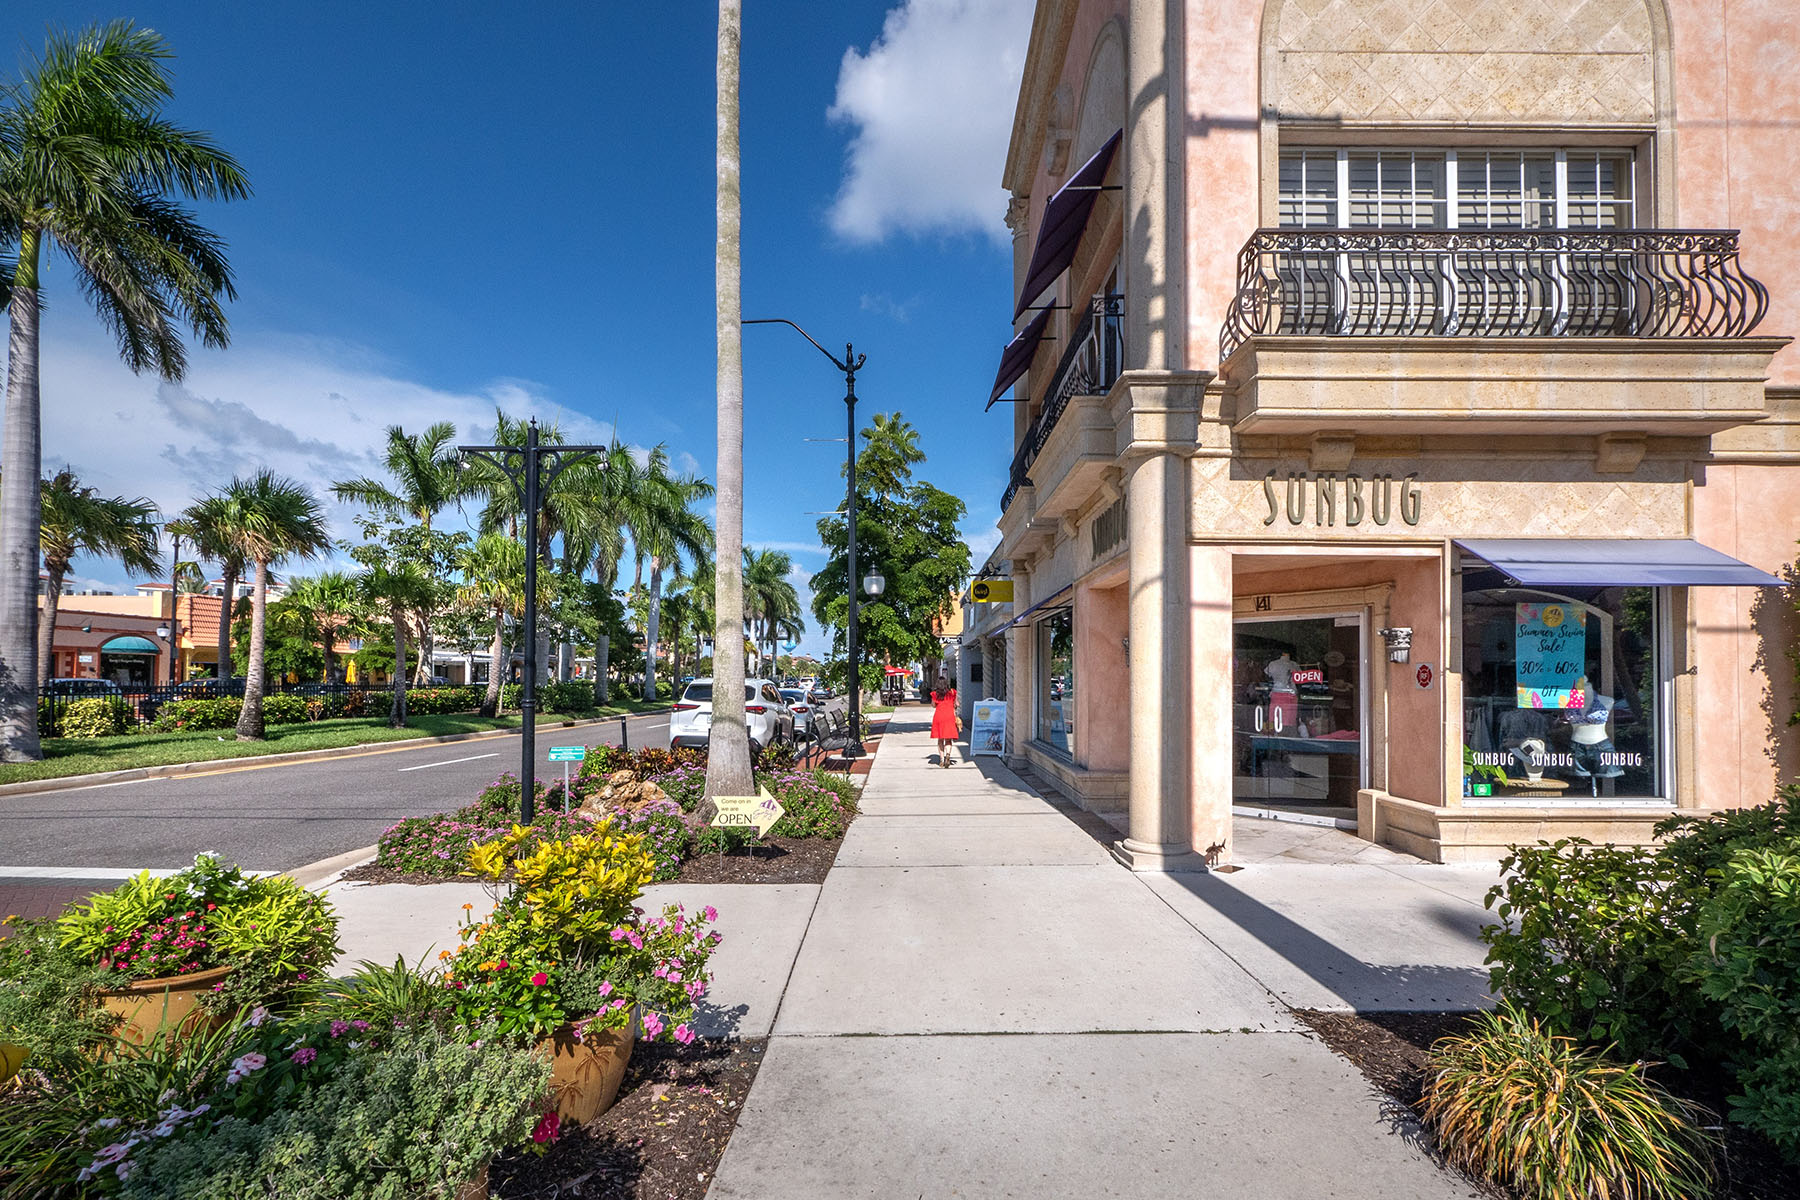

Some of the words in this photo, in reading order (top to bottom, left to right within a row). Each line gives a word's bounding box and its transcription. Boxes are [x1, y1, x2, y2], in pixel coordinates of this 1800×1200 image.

[1264, 469, 1421, 526] SUNBUG
[1517, 624, 1554, 638] Summer
[1557, 624, 1585, 638] Swim
[1537, 639, 1565, 653] Sale!
[1520, 661, 1544, 674] 30%
[1554, 661, 1579, 674] 60%
[1293, 671, 1321, 682] OPEN
[1472, 752, 1514, 766] SUNBUG
[1531, 752, 1573, 766] SUNBUG
[1600, 752, 1642, 766] SUNBUG
[718, 813, 752, 824] OPEN
